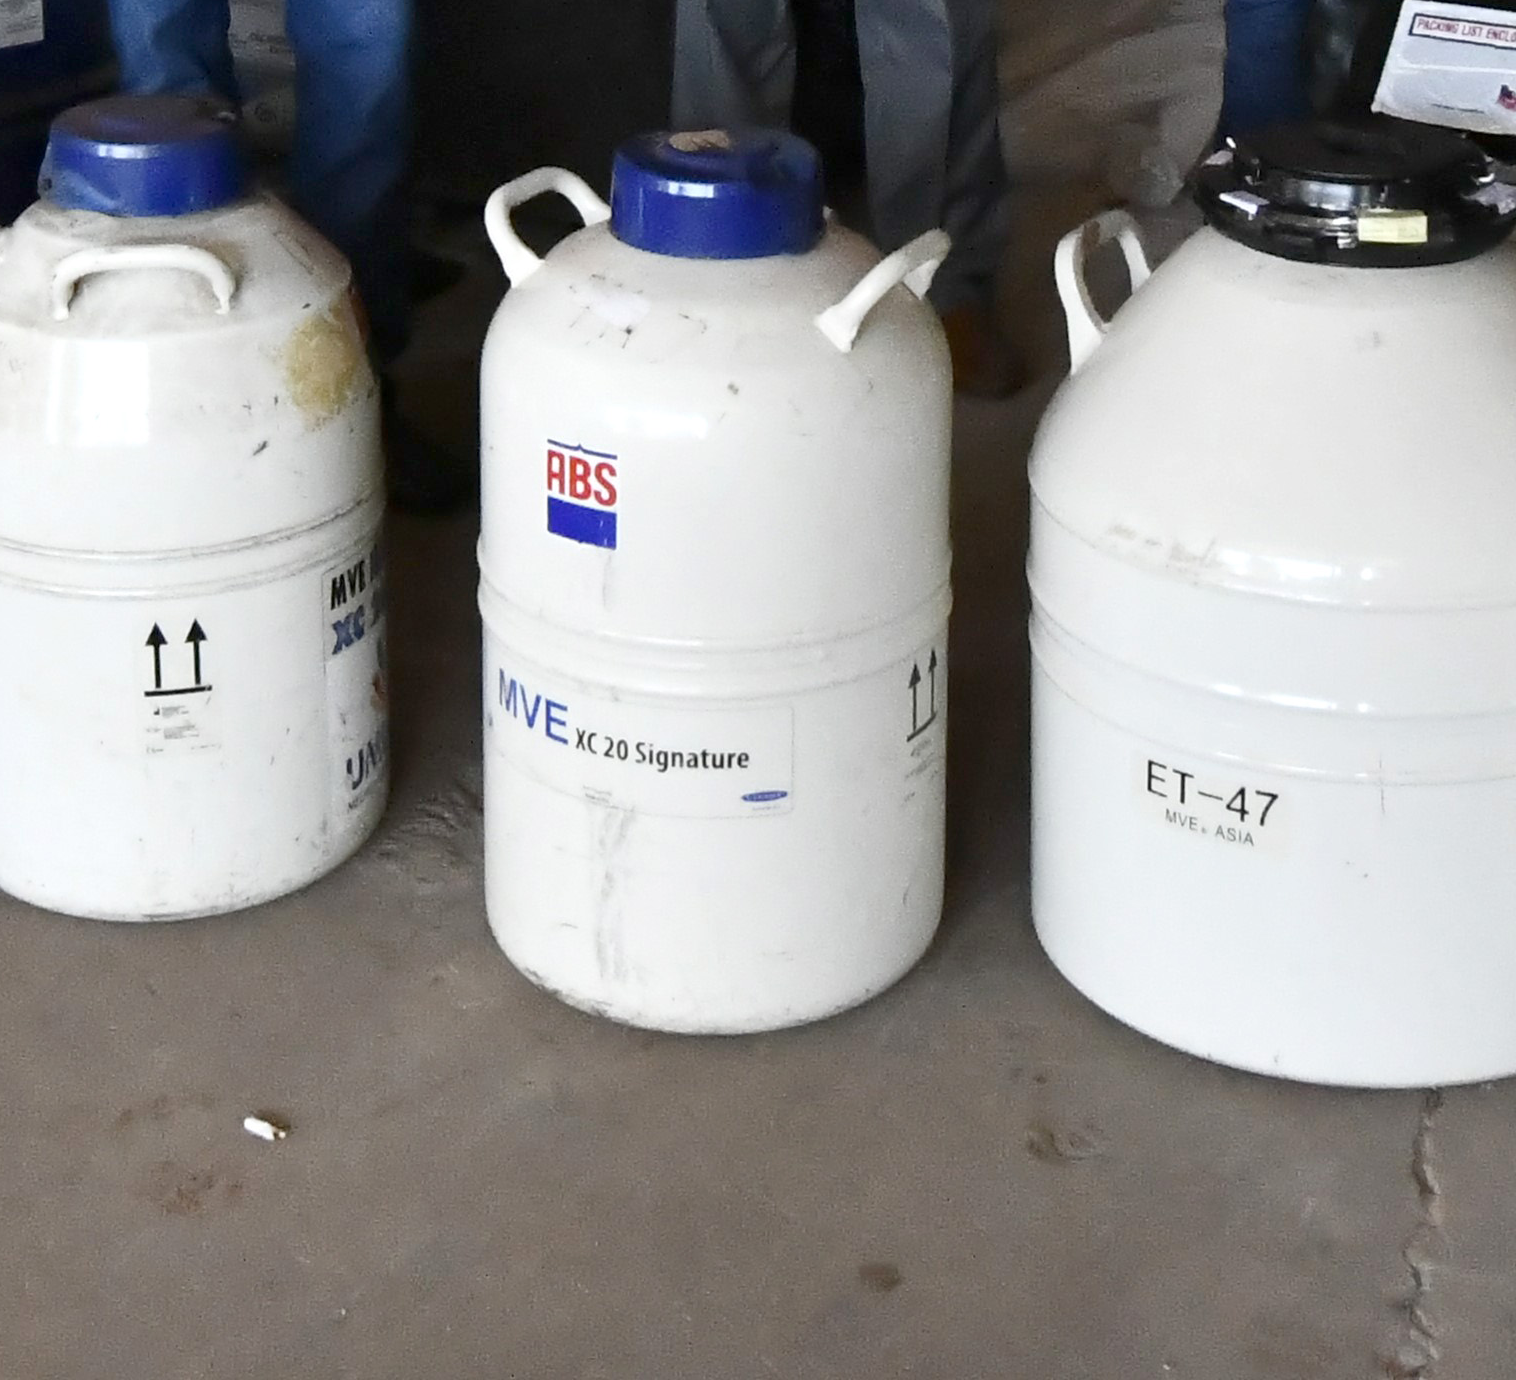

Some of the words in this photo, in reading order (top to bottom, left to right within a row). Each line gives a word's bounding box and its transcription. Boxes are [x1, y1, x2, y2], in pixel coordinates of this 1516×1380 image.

[1416, 18, 1458, 35] PACKING
[1461, 24, 1482, 38] LIST
[547, 449, 617, 507] ABS
[332, 604, 365, 656] XC
[499, 667, 569, 745] MVE
[576, 727, 597, 755] XC
[603, 736, 628, 761] 20
[636, 742, 750, 772] Signature
[1146, 759, 1279, 827] ET-47
[1215, 824, 1254, 847] ASIA
